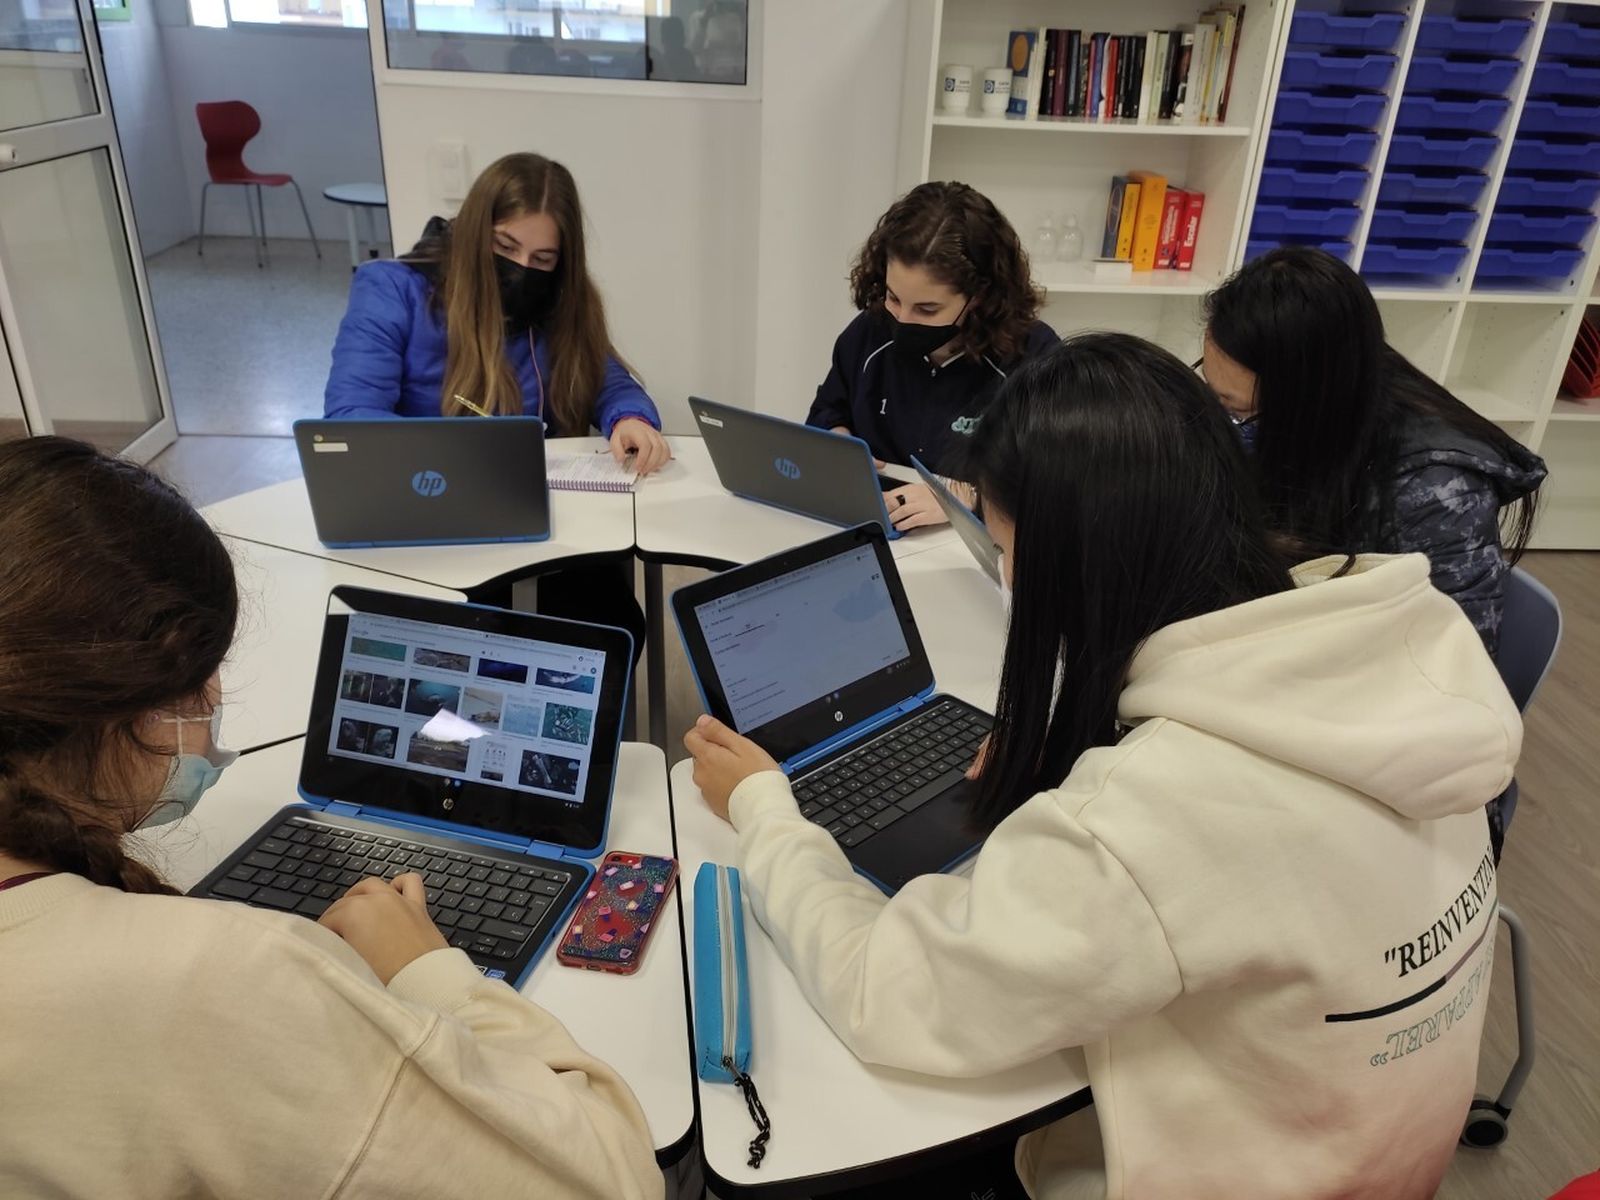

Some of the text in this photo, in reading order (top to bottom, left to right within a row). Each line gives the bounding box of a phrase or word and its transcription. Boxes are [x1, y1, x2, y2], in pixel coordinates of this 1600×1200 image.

[1184, 215, 1198, 248] Escolar
[879, 398, 888, 415] 1
[416, 470, 443, 497] hp
